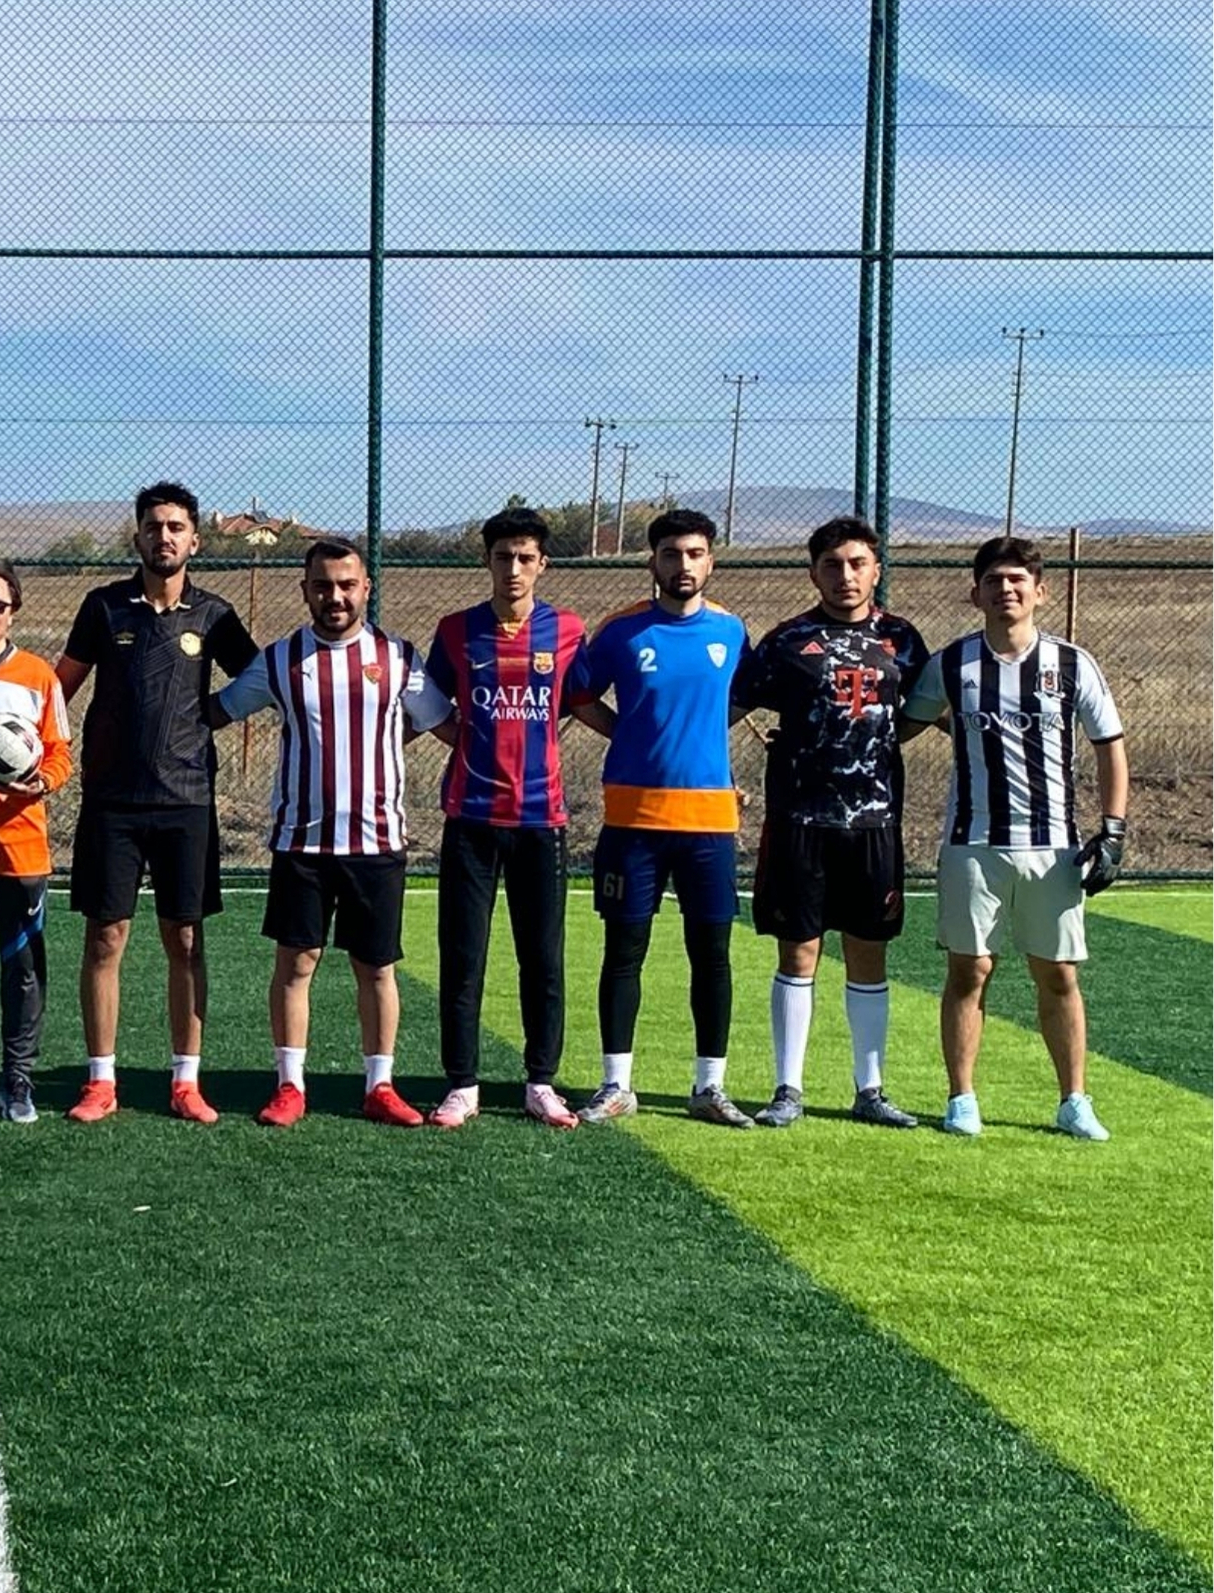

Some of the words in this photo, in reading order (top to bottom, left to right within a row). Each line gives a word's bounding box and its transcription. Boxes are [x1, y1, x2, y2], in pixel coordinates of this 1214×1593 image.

[639, 647, 658, 672] 2
[471, 685, 551, 711] QATAR
[836, 667, 878, 718] T
[490, 707, 550, 721] AIRWAYS
[958, 711, 1066, 732] TOYOTA
[603, 873, 624, 900] 61
